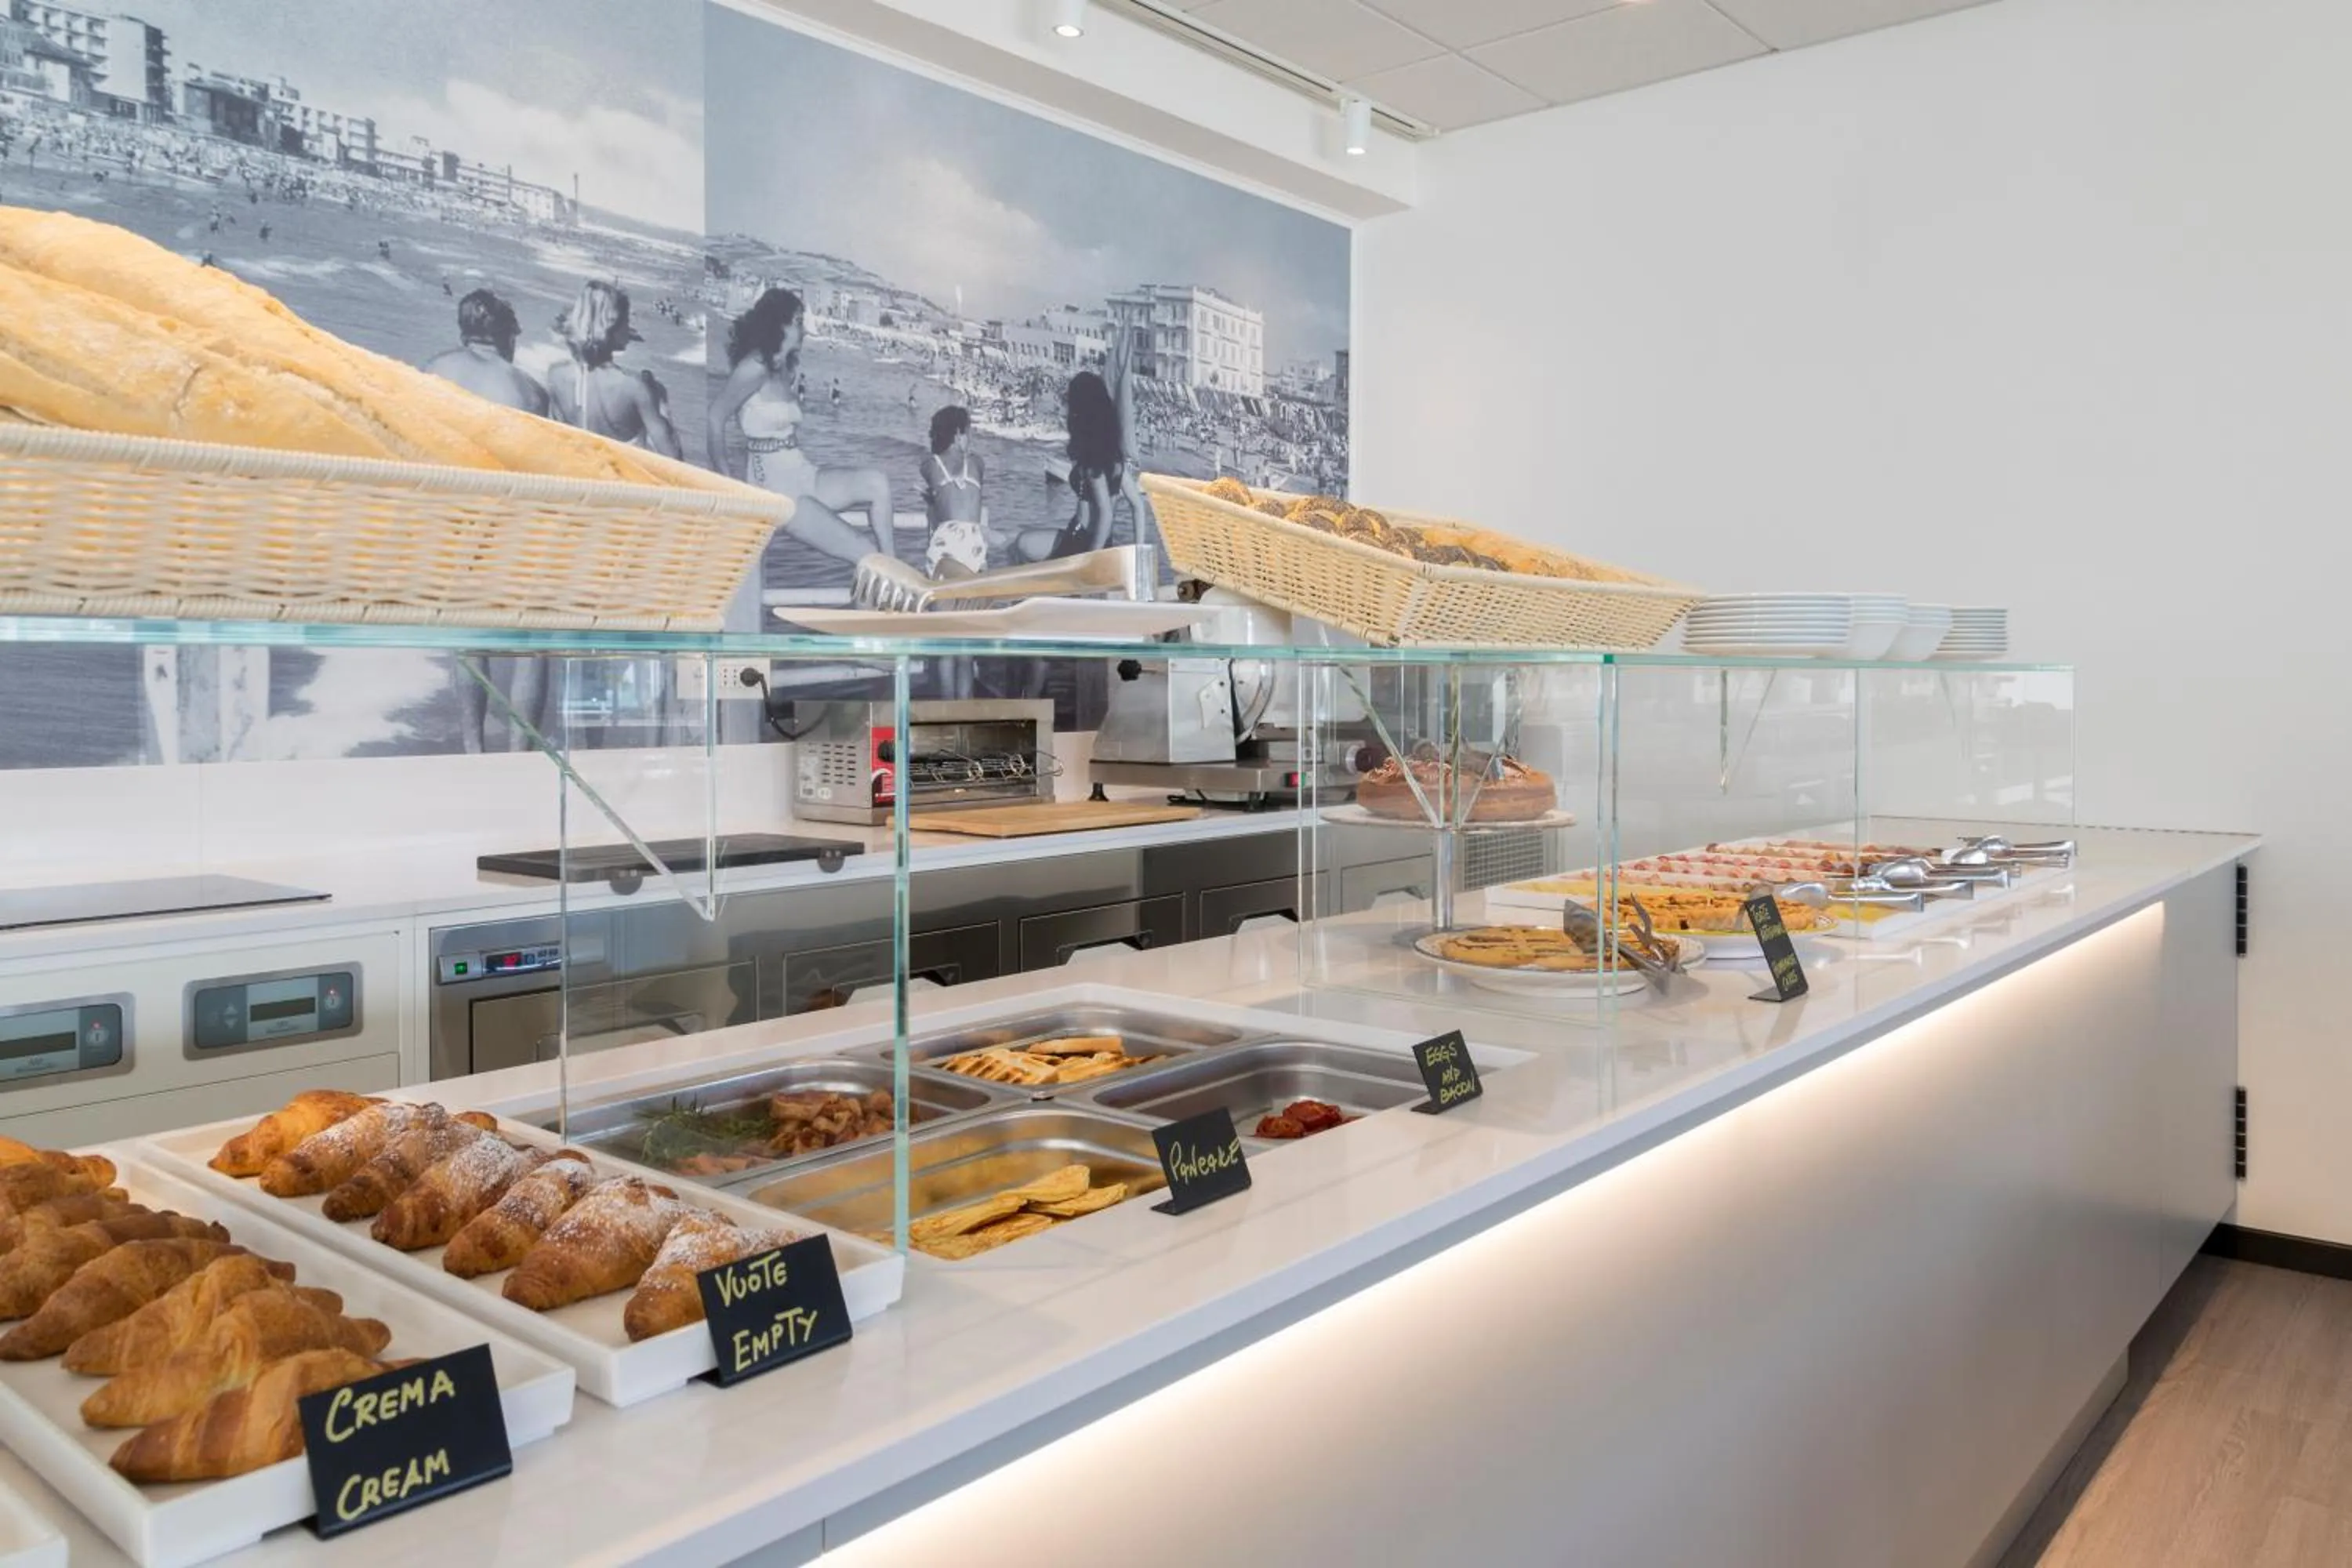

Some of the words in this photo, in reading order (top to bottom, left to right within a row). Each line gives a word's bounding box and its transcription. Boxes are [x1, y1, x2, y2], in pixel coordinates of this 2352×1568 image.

[715, 1251, 788, 1307] VUOTE
[733, 1307, 818, 1372] EMPTY
[325, 1370, 456, 1443] CREMA
[336, 1449, 450, 1521] CREAM
